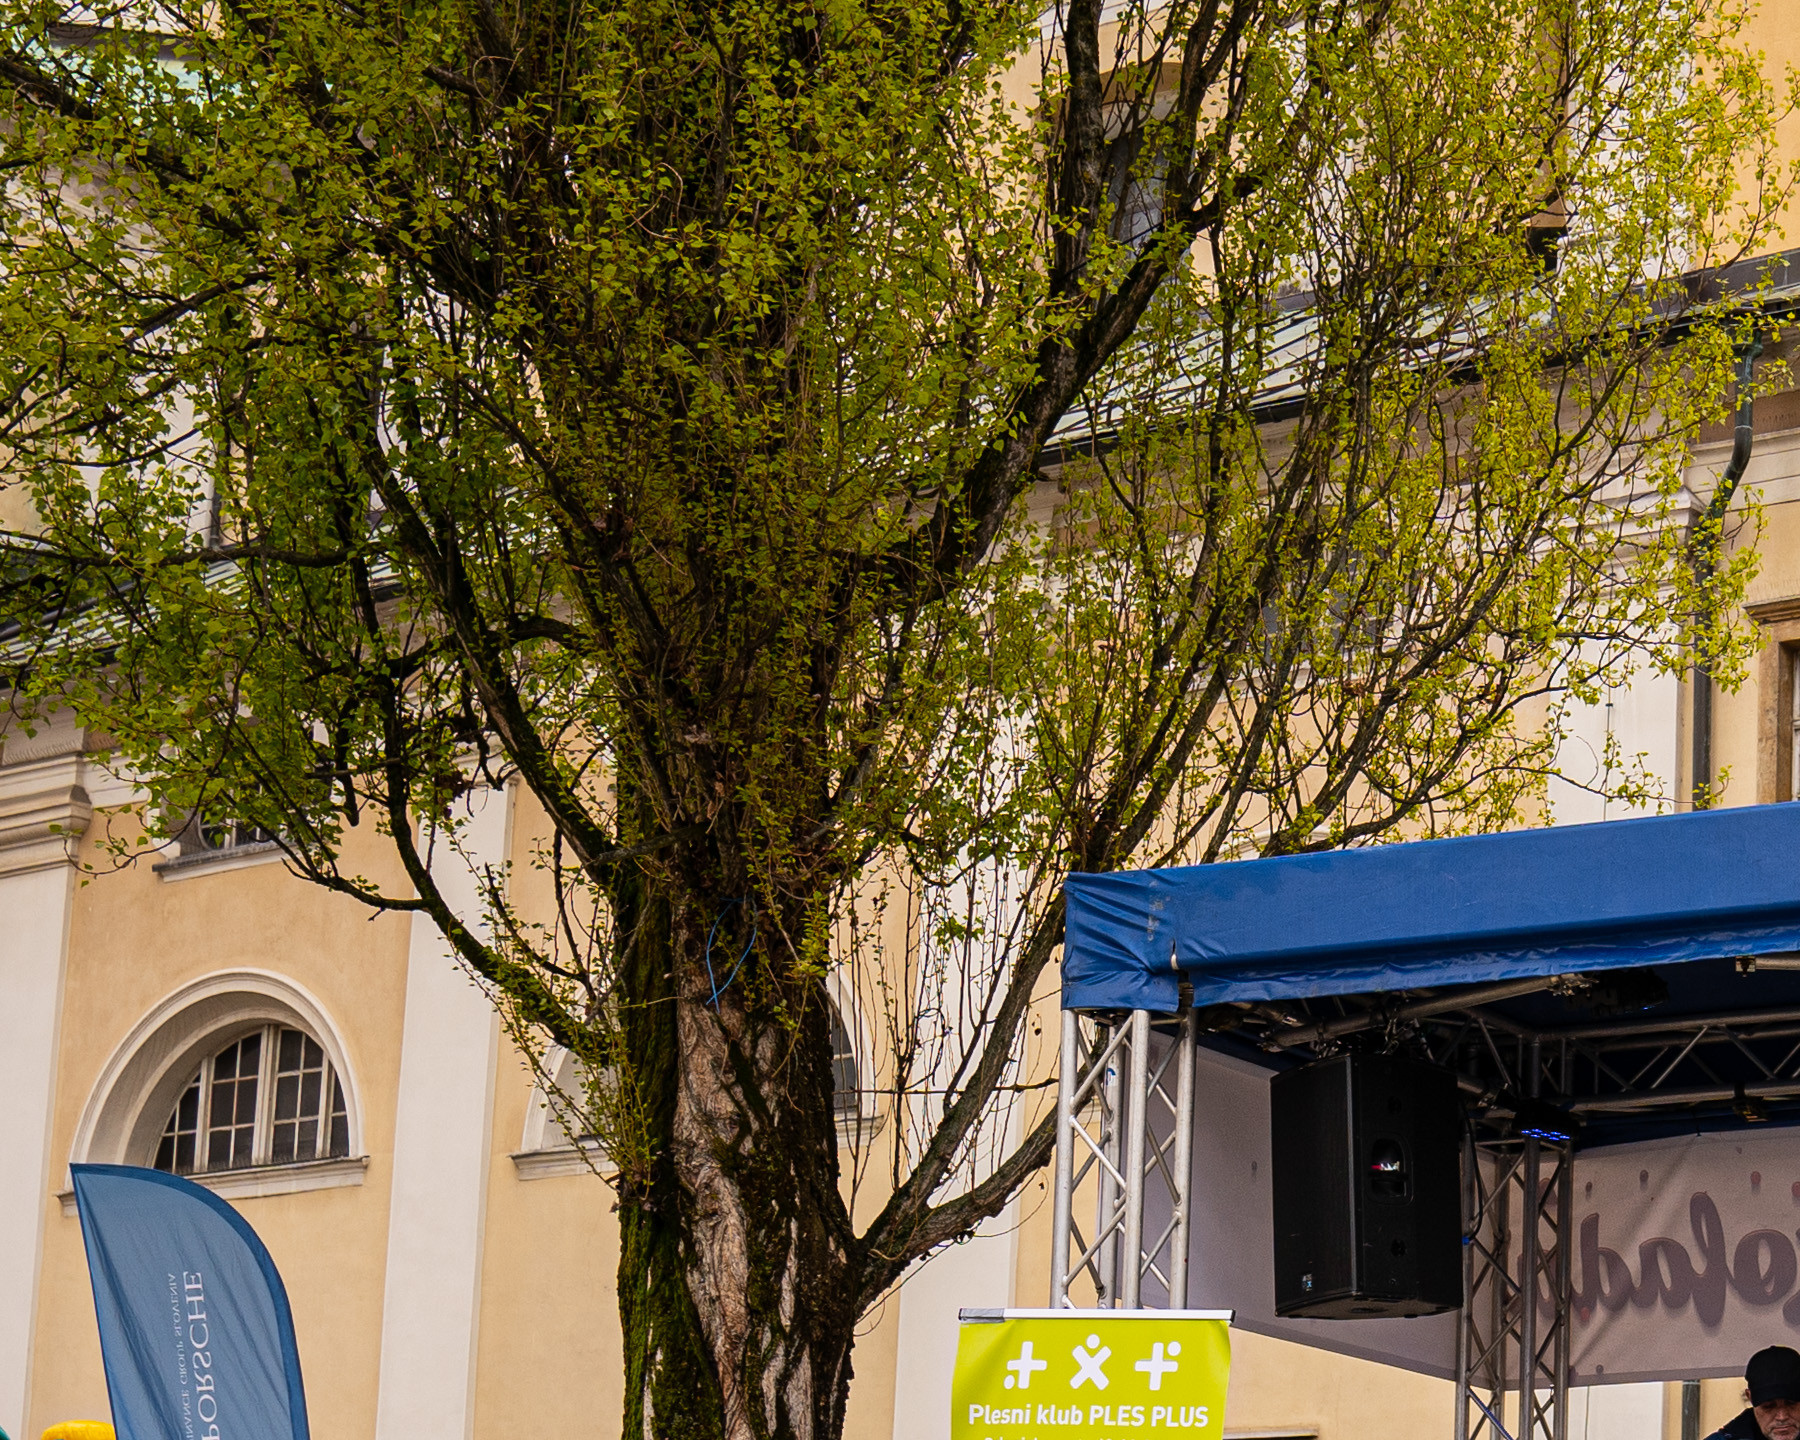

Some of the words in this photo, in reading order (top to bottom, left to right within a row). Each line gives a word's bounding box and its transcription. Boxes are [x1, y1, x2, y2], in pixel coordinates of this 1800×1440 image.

[968, 1403, 1031, 1426] Plesni
[1036, 1404, 1084, 1426] klub
[1089, 1405, 1145, 1427] PLES
[1151, 1406, 1209, 1428] PLUS
